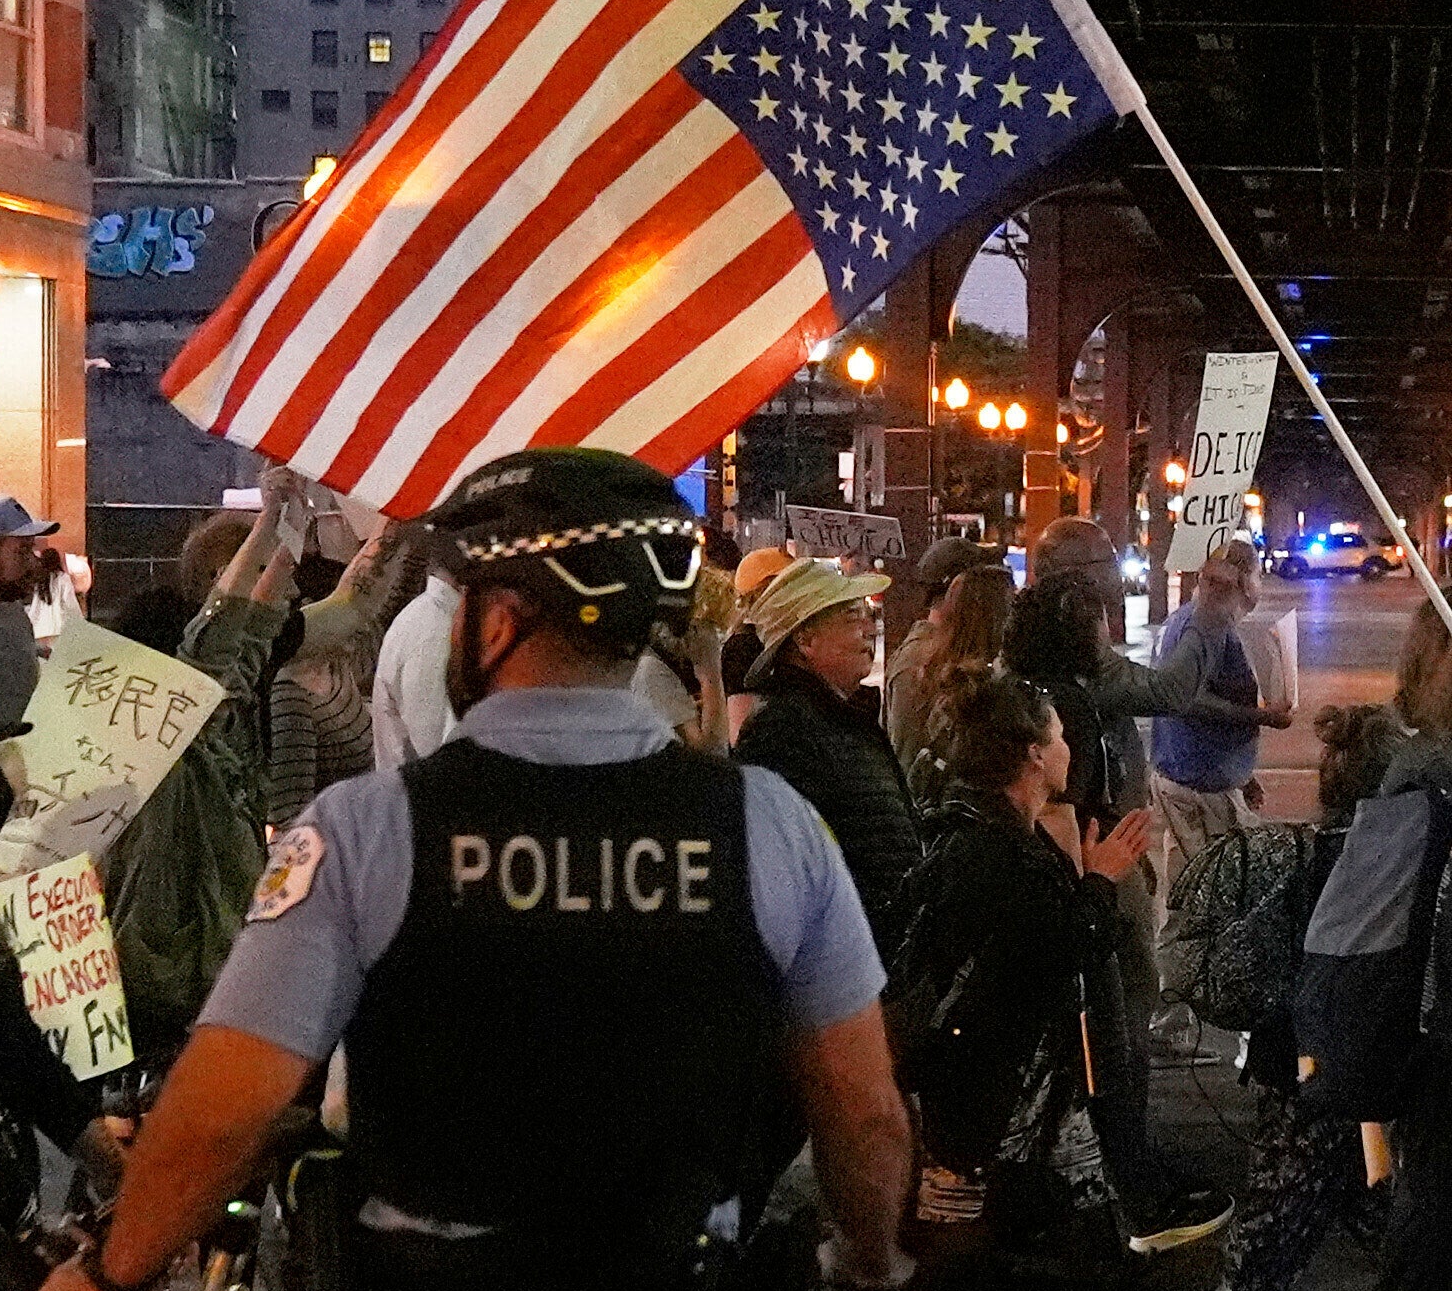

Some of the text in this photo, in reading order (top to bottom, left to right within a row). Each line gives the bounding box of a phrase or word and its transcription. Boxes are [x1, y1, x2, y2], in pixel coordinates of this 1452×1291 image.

[1203, 386, 1222, 402] IT
[64, 656, 199, 751] 移民官
[450, 834, 712, 912] POLICE
